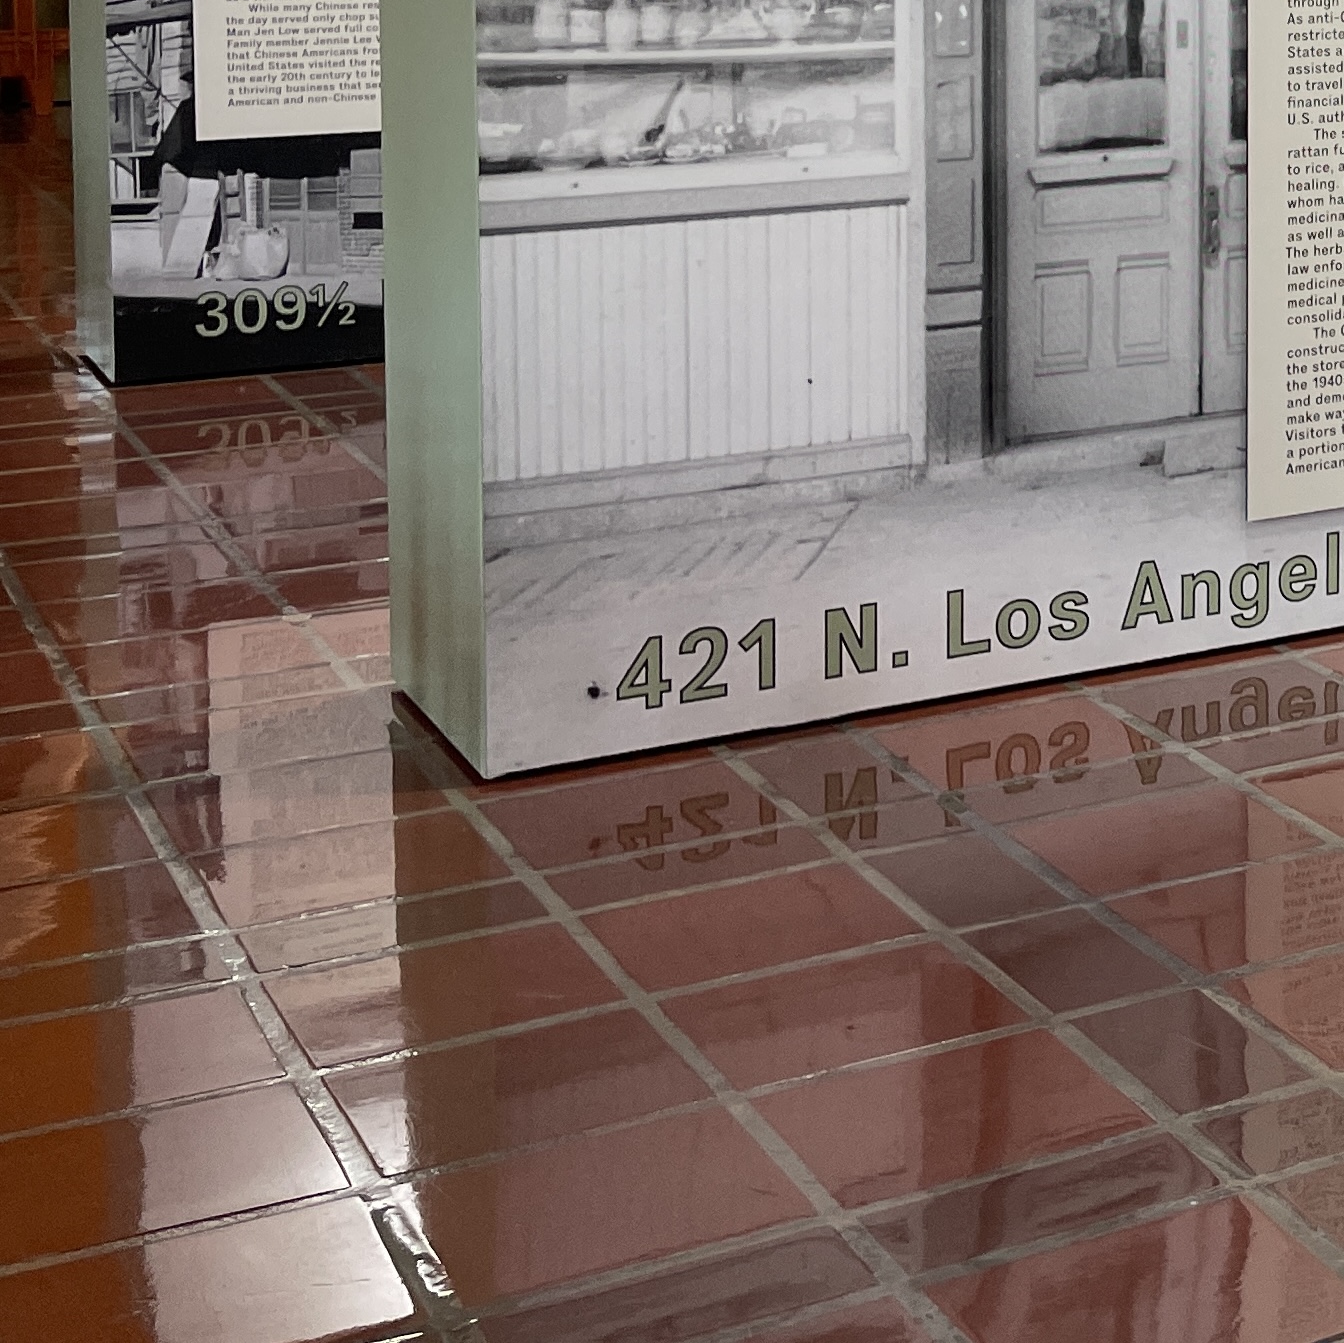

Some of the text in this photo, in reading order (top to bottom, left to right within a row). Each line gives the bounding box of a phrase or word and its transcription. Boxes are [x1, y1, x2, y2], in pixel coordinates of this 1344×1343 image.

[1287, 112, 1313, 125] U.S.
[1286, 411, 1320, 425] make
[615, 617, 777, 711] 421
[823, 602, 911, 681] N.
[945, 588, 1092, 663] Los
